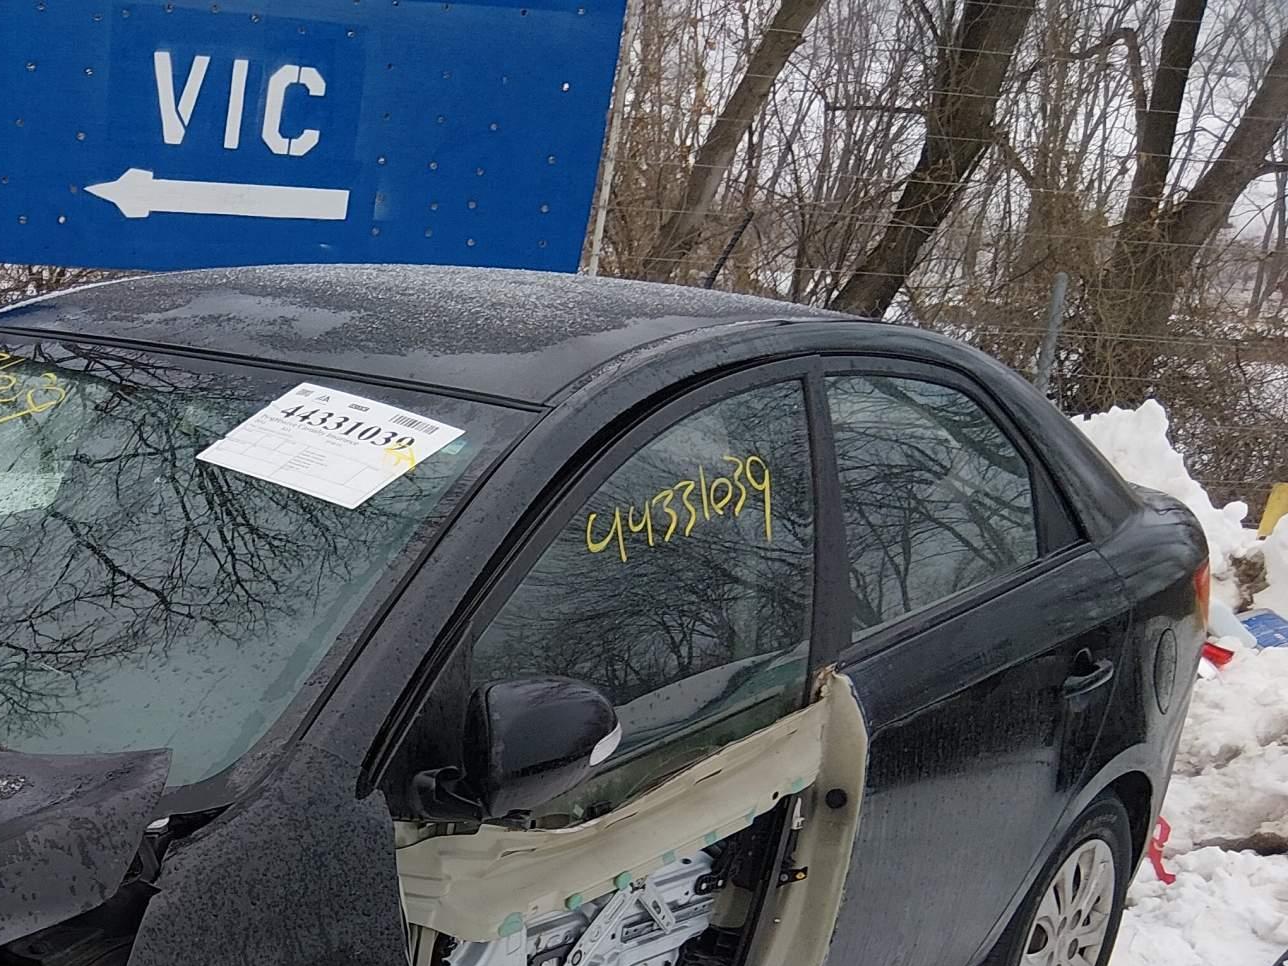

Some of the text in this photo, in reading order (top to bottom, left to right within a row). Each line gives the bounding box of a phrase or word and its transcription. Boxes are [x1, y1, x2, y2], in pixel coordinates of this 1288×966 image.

[154, 51, 326, 156] VIC
[280, 404, 415, 451] 44331039
[586, 455, 772, 562] 44331039
